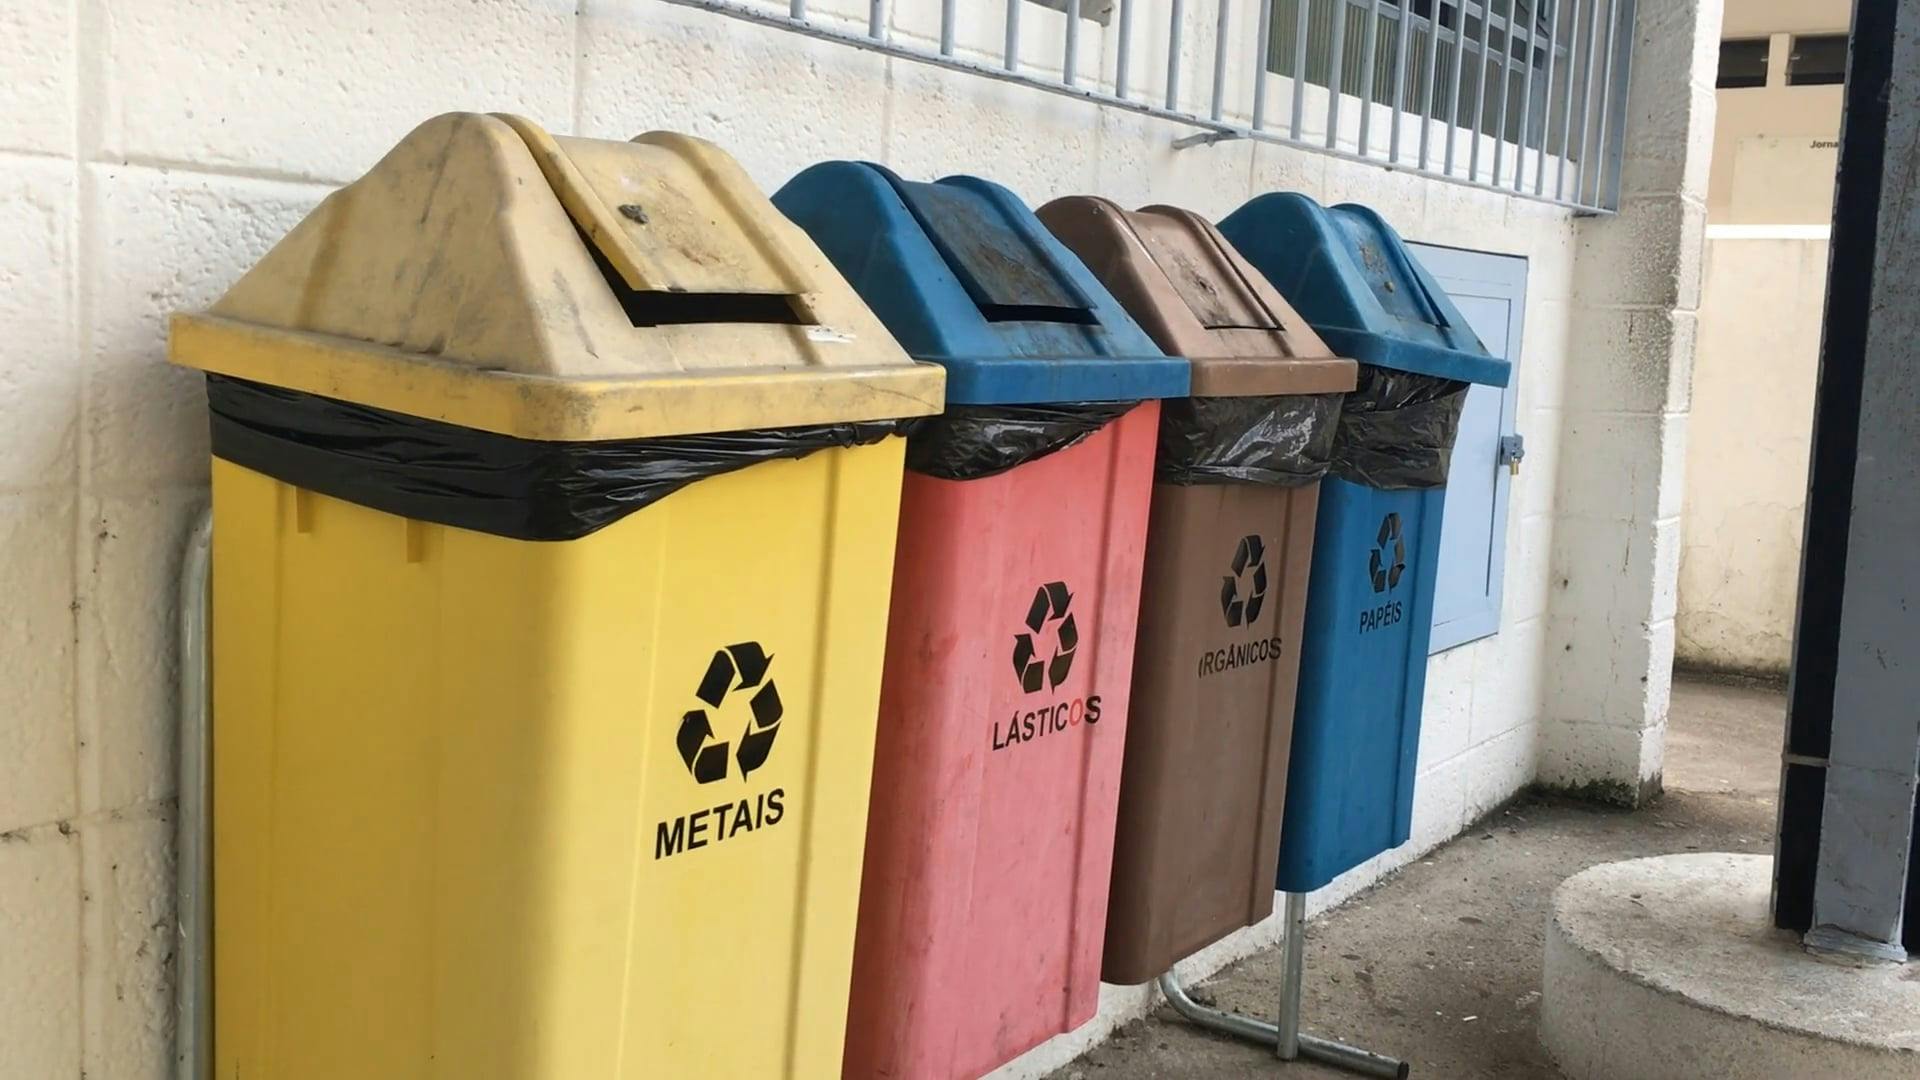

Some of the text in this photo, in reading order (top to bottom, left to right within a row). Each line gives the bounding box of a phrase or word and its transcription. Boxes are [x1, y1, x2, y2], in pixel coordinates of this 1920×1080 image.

[1359, 600, 1402, 634] PAPÉIS
[992, 695, 1102, 751] LÁSTICOS
[655, 788, 785, 860] METAIS
